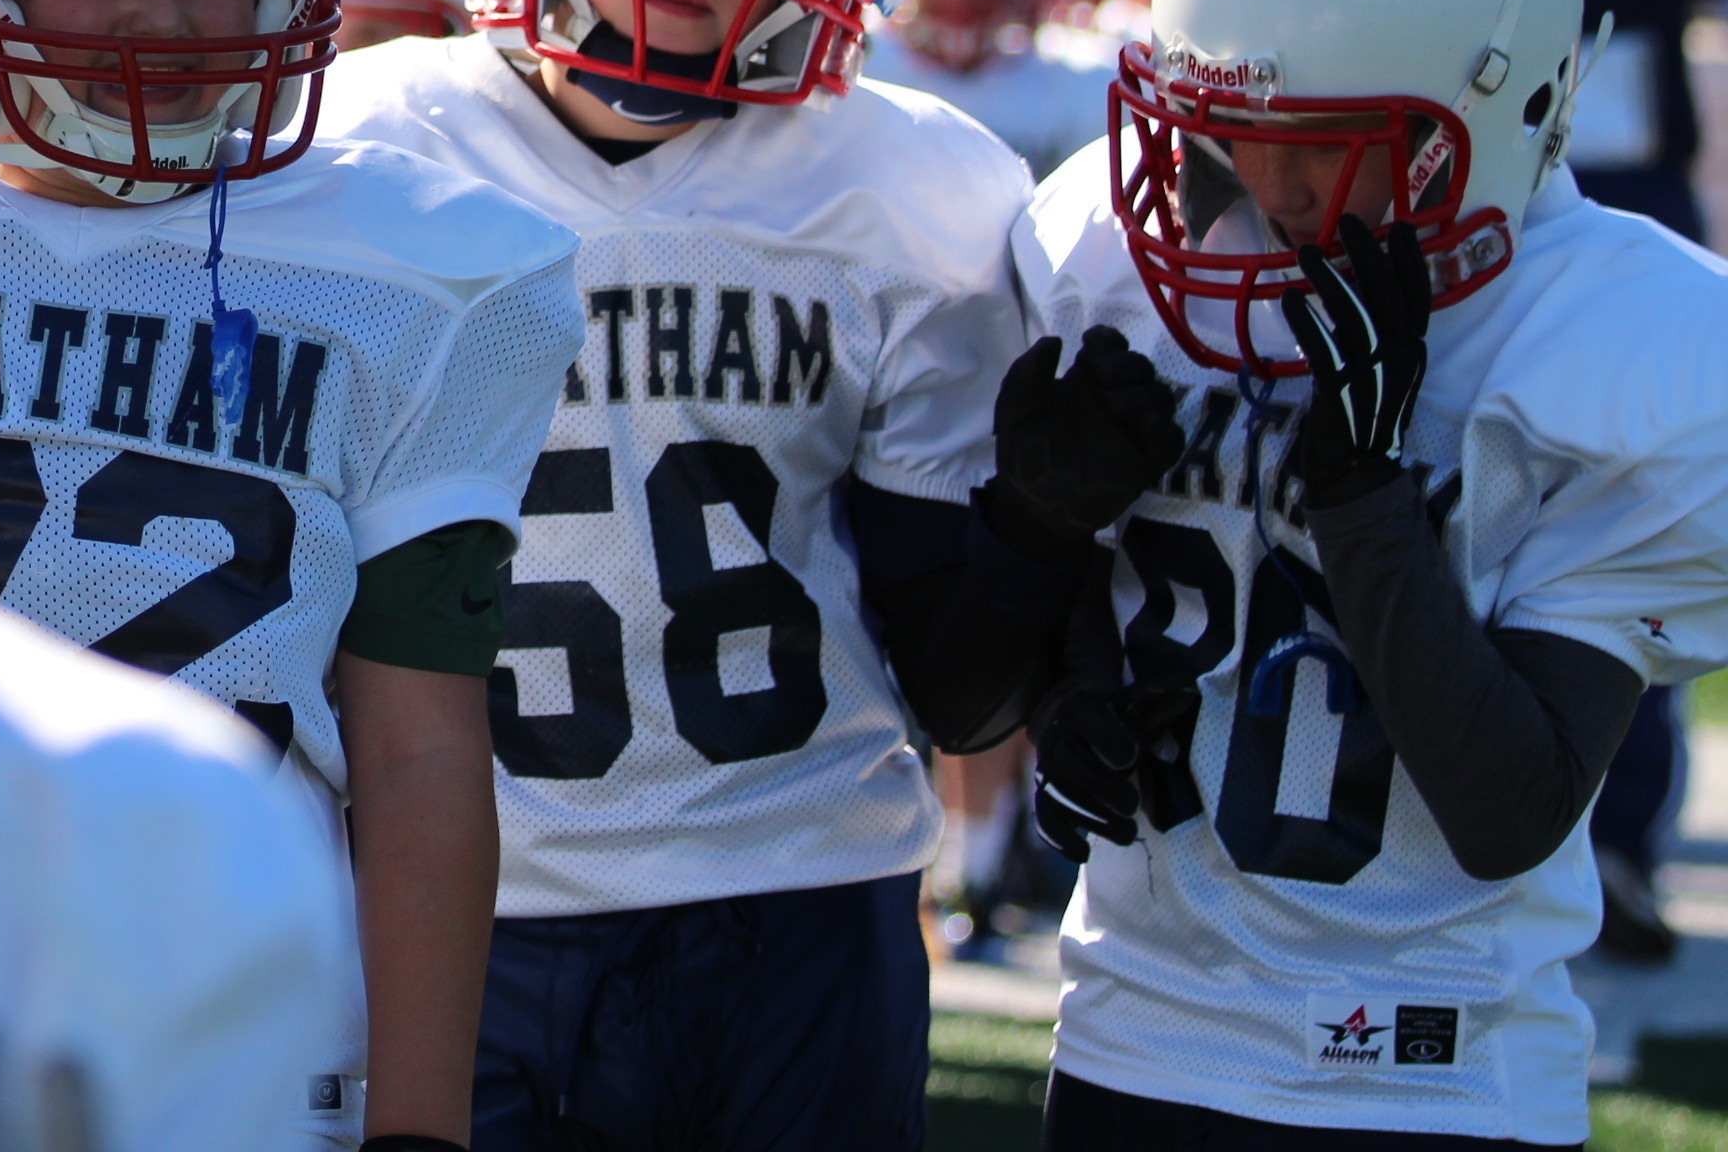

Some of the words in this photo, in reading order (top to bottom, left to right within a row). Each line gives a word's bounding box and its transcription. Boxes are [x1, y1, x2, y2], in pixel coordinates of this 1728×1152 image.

[1187, 53, 1249, 88] Riddell
[132, 155, 186, 169] ddell
[560, 282, 834, 408] THAM
[486, 439, 828, 780] 58
[1319, 1046, 1381, 1061] Alleson
